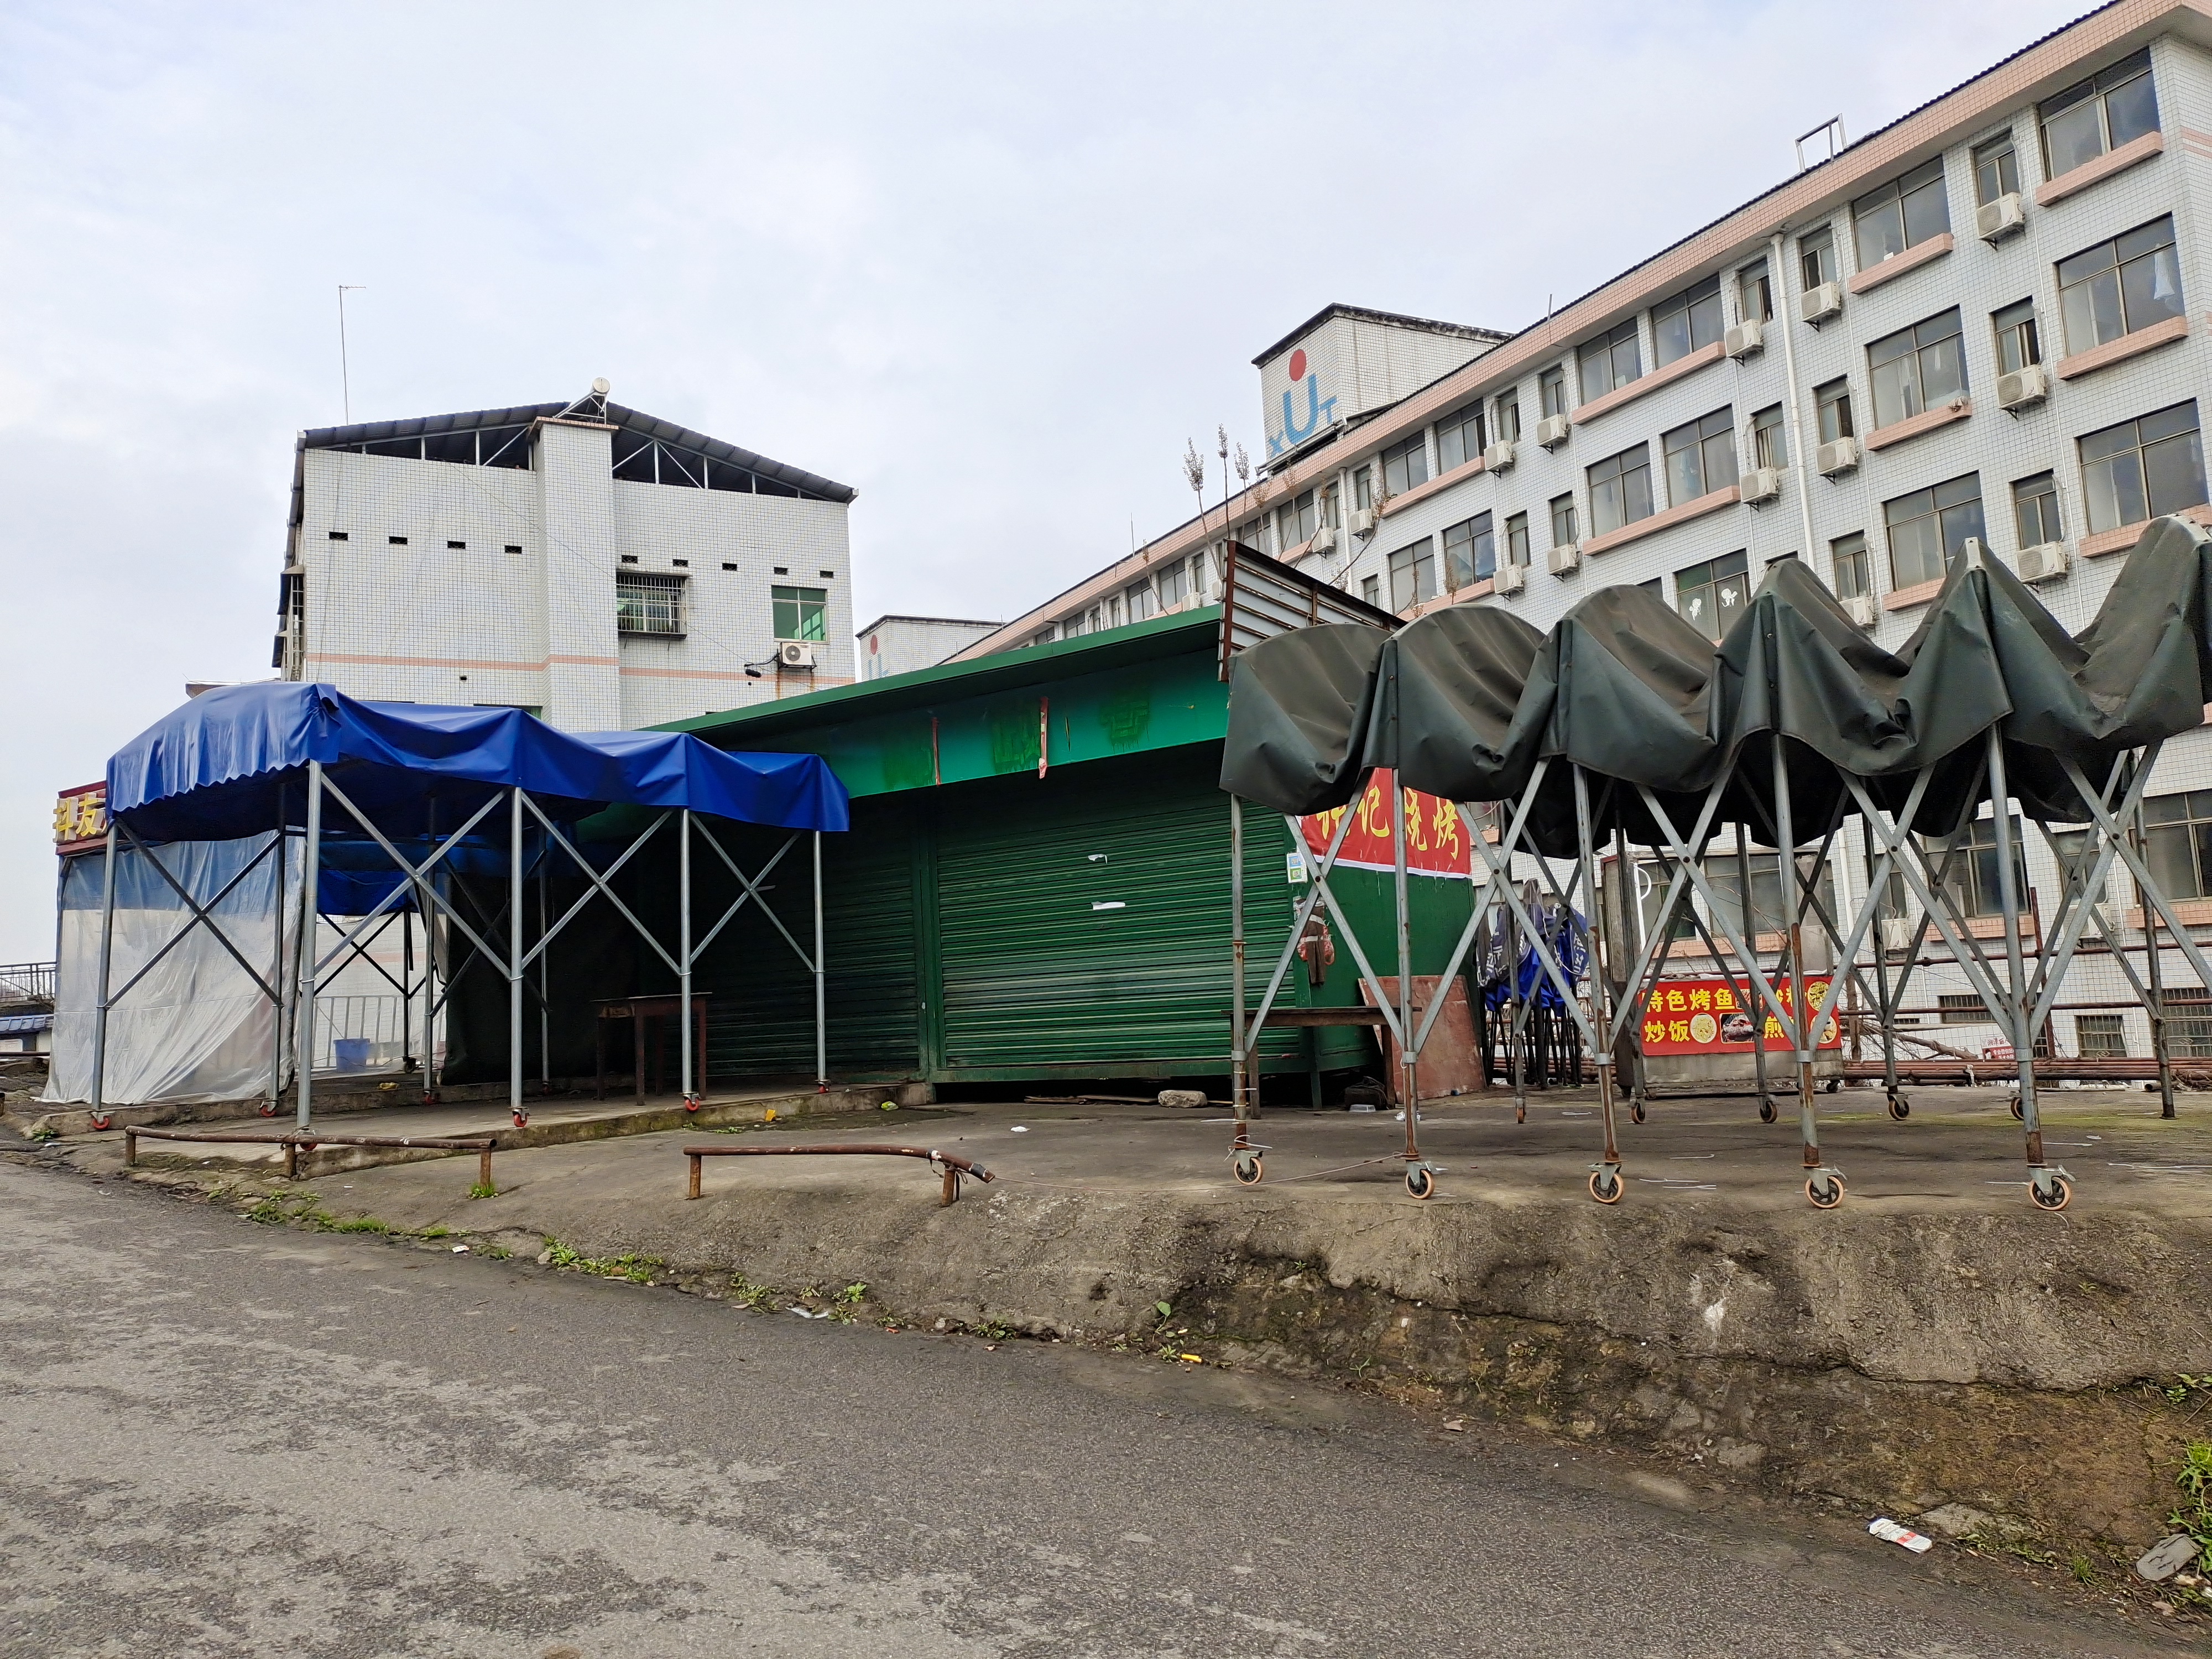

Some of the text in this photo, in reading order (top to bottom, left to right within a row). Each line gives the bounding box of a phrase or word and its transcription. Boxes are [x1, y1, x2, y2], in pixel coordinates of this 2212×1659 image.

[1642, 988, 1735, 1013] 特色烤鱼
[1645, 1020, 1690, 1043] 炒饭
